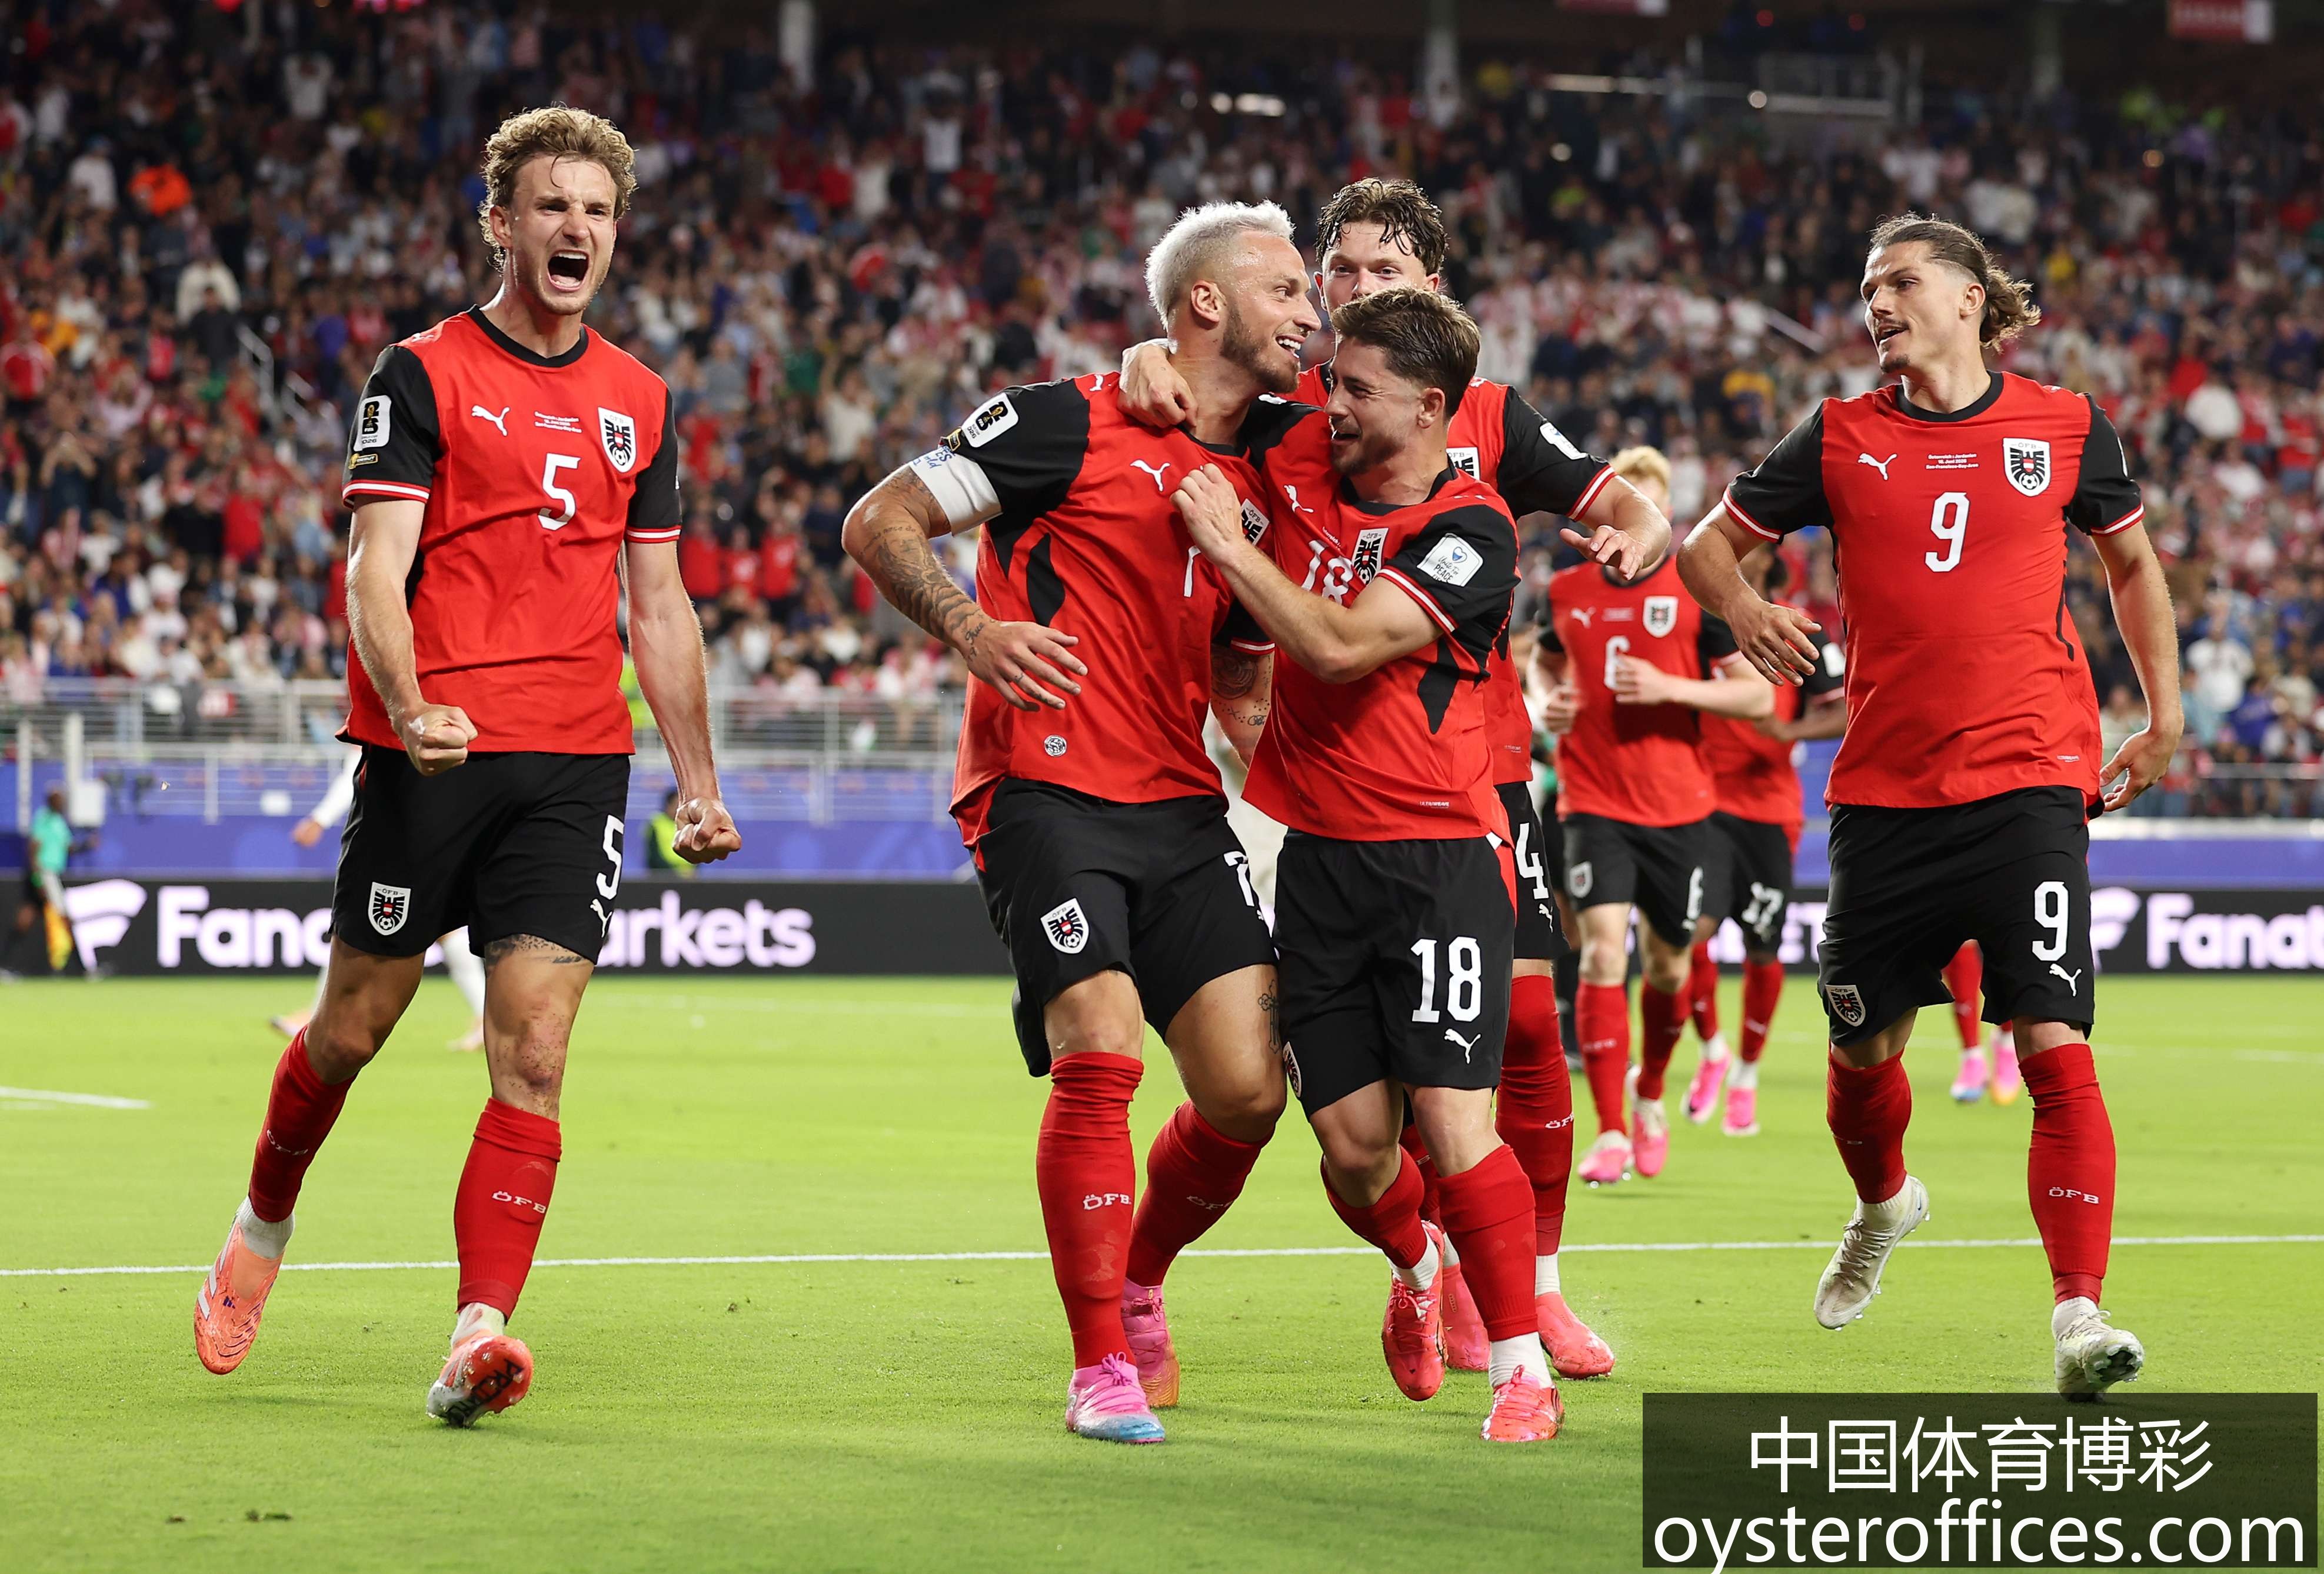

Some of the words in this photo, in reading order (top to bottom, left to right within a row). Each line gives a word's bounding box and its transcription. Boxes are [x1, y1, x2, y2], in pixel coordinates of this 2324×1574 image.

[538, 452, 581, 531] 5
[1925, 492, 1970, 573] 9
[1433, 564, 1453, 581] PEACE
[596, 815, 624, 900] 5
[1224, 851, 1254, 907] 7
[1514, 822, 1549, 900] 4
[597, 889, 817, 968] arkets
[2032, 881, 2069, 961] 9
[1410, 936, 1481, 1023] 18
[492, 1190, 547, 1213] ÖFB
[1083, 1193, 1132, 1210] ÖFB
[2049, 1186, 2099, 1205] ÖFB
